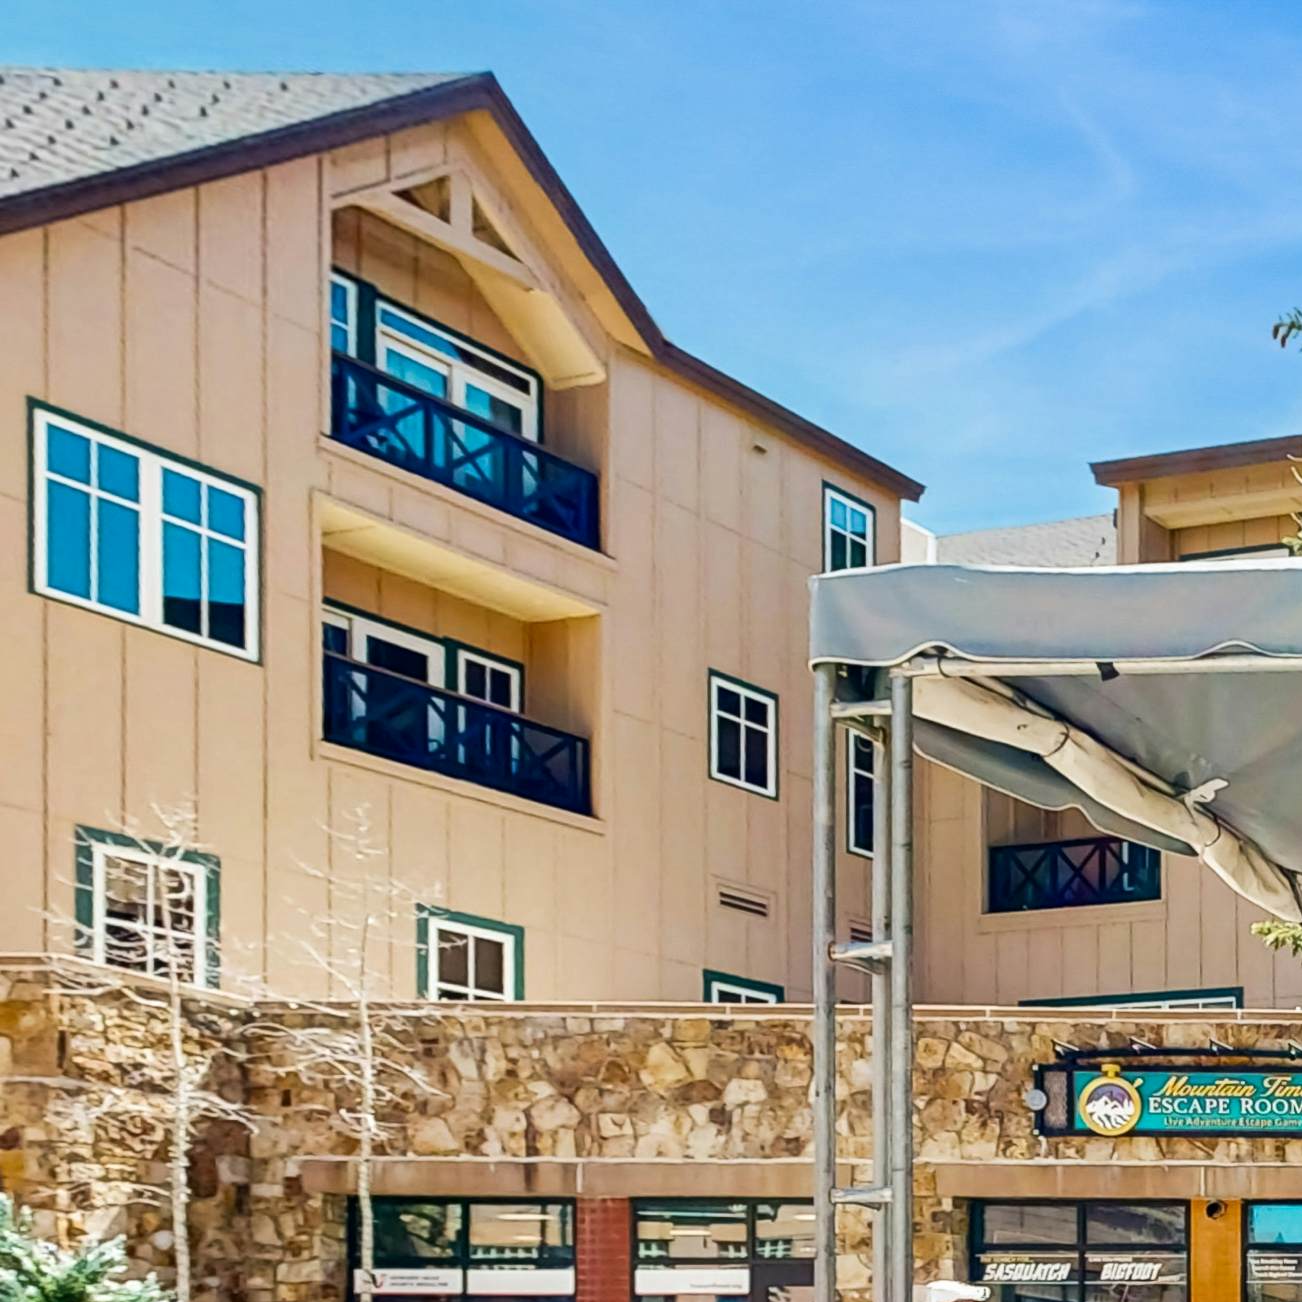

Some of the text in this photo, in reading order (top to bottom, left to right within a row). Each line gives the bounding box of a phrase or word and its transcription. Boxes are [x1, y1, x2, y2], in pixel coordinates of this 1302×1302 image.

[1152, 1075, 1256, 1097] Mountain
[1149, 1097, 1230, 1114] ESCAPE
[1186, 1117, 1237, 1127] Adventure
[1239, 1116, 1272, 1129] Escape
[1275, 1117, 1302, 1127] Game
[982, 1262, 1072, 1281] SASQUATCH
[1100, 1262, 1162, 1281] BIGFOOT
